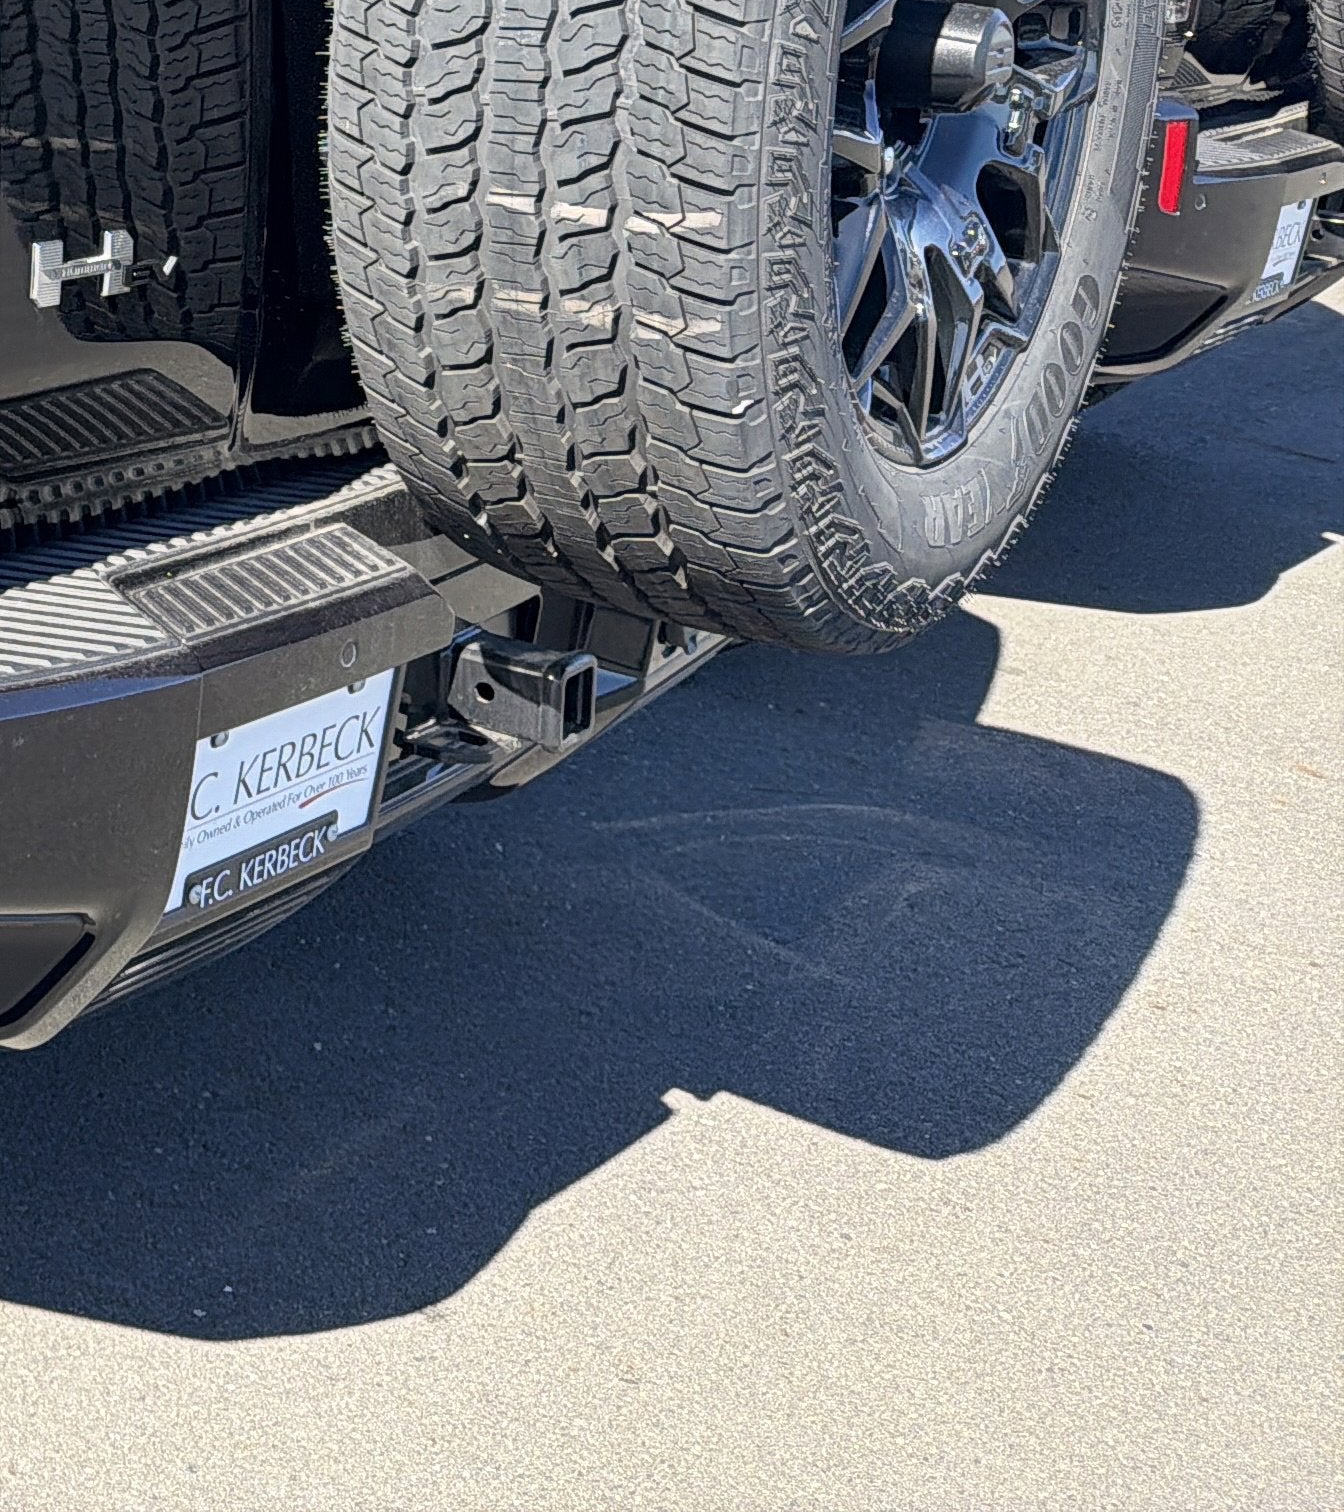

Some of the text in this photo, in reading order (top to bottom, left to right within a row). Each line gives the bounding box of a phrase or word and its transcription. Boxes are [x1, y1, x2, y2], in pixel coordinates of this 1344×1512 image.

[1274, 222, 1303, 249] BECK
[233, 705, 381, 805] KERBECK
[243, 794, 287, 824] Operated
[287, 790, 302, 807] For
[303, 781, 326, 799] Over
[328, 772, 344, 788] 100
[346, 764, 368, 781] Years
[200, 826, 327, 908] F.C. KERBECK
